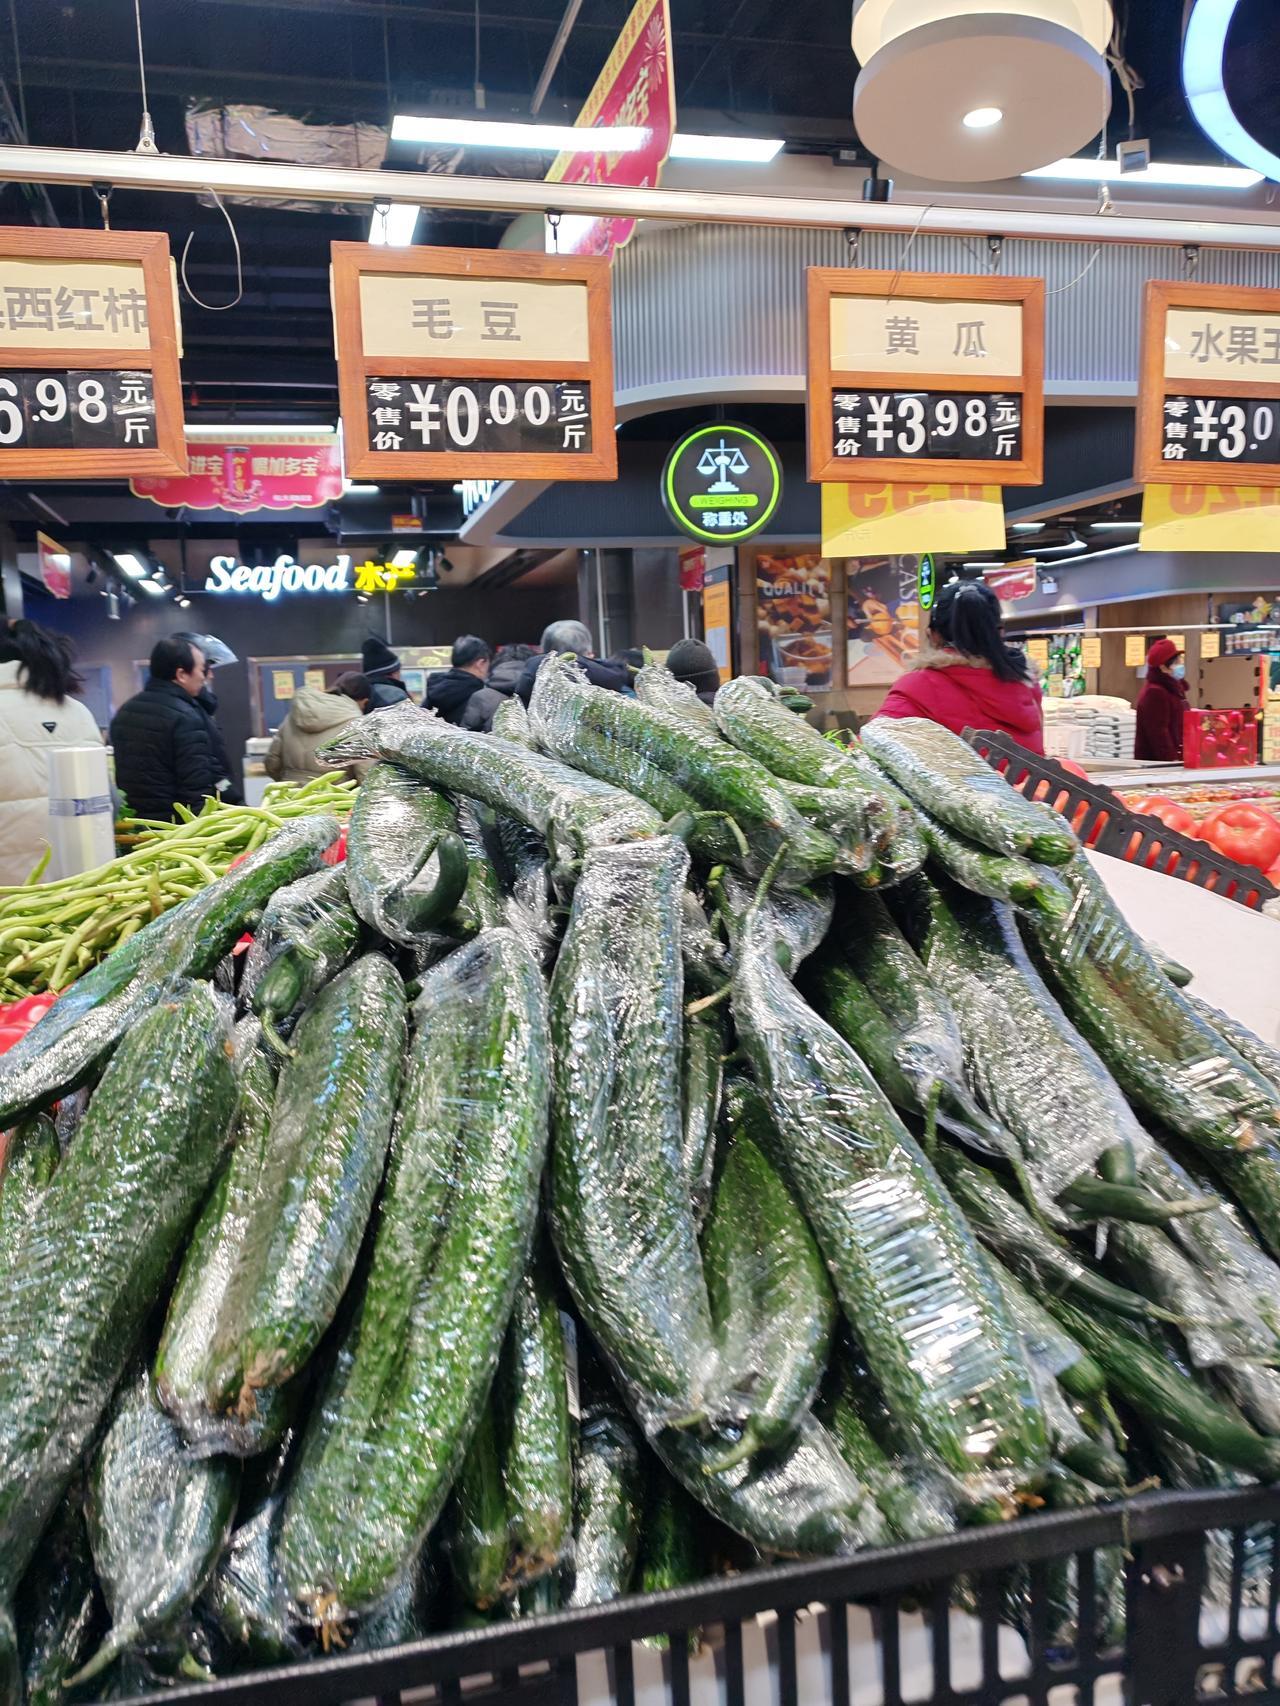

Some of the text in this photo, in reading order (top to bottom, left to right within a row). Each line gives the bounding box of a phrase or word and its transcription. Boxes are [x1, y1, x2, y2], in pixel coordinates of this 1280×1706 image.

[0, 285, 149, 334] 西红柿
[412, 298, 521, 341] 毛豆
[884, 315, 988, 358] 黄瓜
[369, 382, 404, 450] 零售价
[409, 383, 550, 446] ¥0.00
[833, 394, 862, 456] 零售价
[866, 395, 988, 453] ¥3.98
[1162, 401, 1190, 460] 零售价
[187, 455, 224, 476] 进宝
[702, 511, 748, 527] 称重处
[205, 554, 351, 601] Seafood
